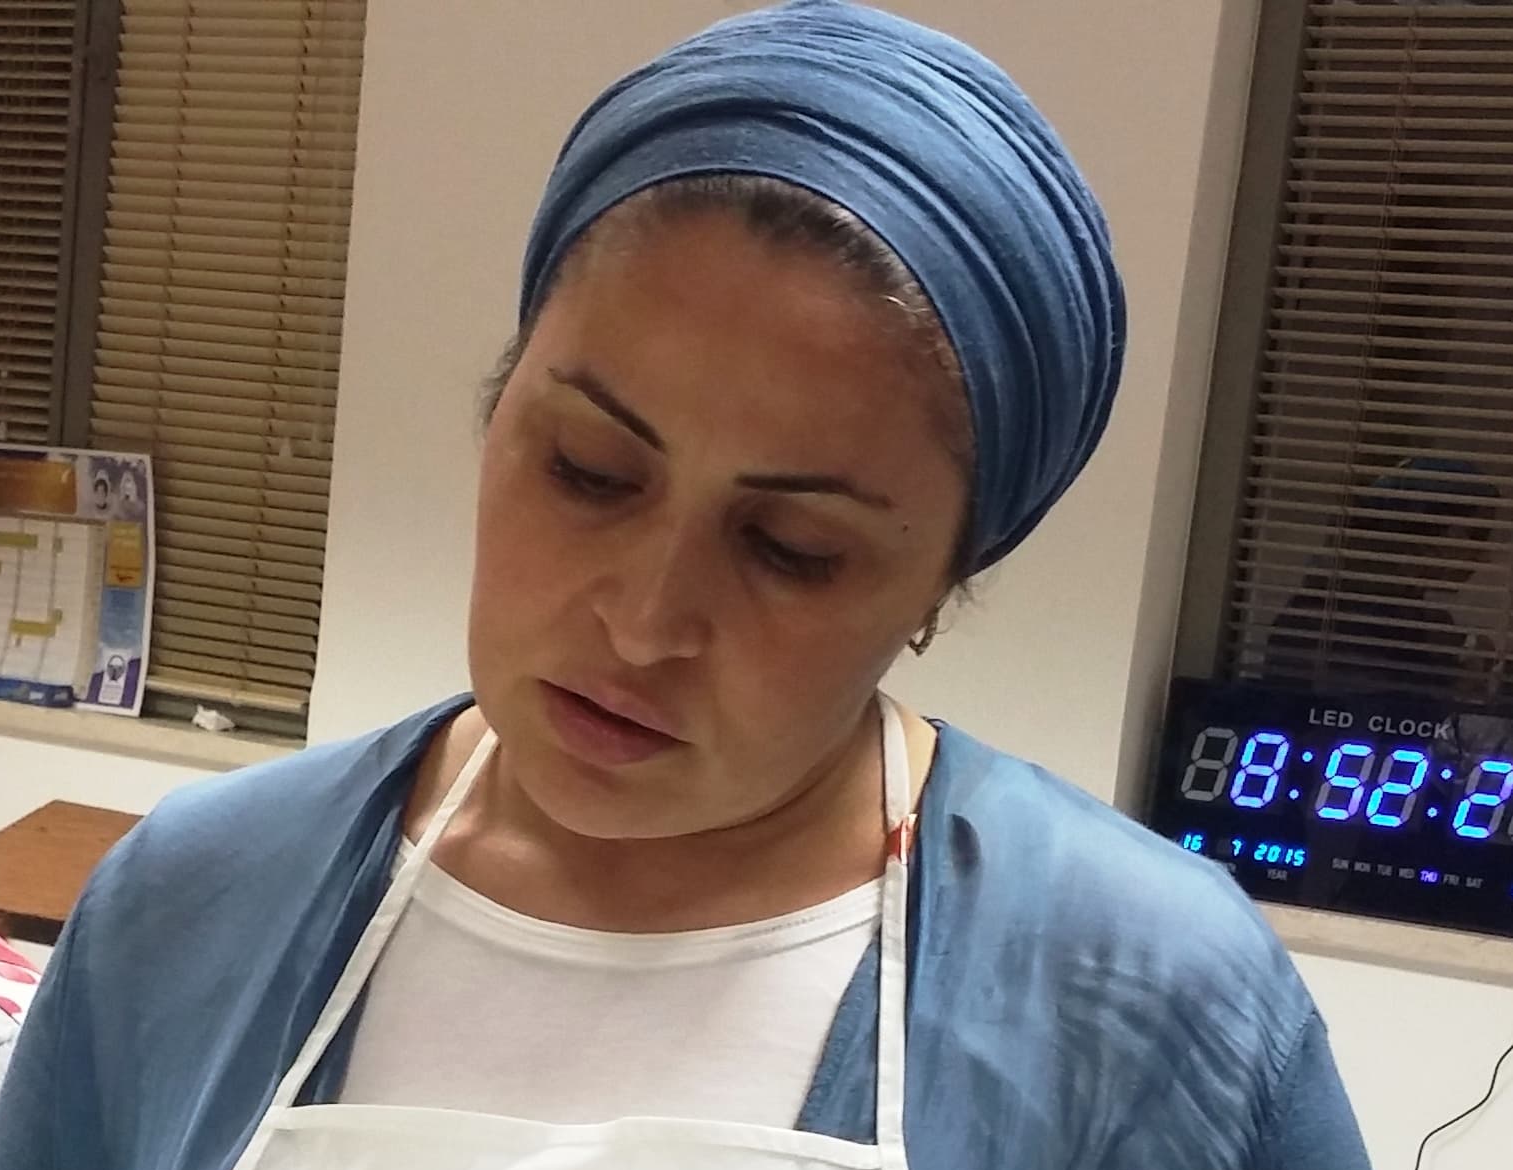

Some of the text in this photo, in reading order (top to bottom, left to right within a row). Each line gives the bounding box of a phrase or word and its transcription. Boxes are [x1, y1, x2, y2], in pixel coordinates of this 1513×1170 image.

[1309, 708, 1451, 741] LED CLOCK
[1253, 843, 1306, 867] 2015
[1267, 868, 1288, 881] YEAR
[1332, 858, 1484, 889] SUN MON TUE WED THU FRI SAT
